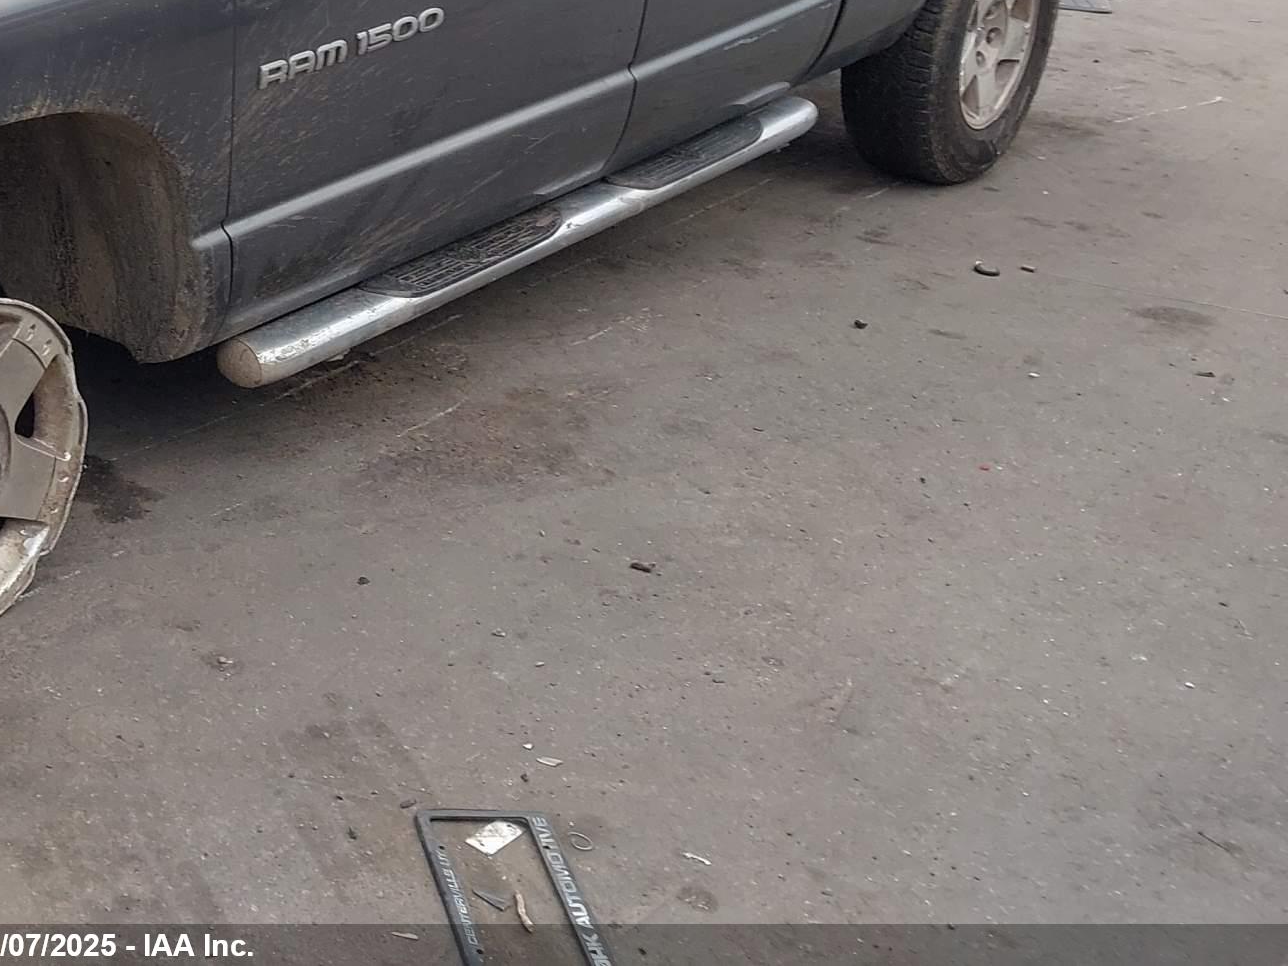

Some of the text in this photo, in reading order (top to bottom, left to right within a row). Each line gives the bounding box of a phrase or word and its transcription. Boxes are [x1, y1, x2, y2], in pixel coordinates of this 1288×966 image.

[259, 7, 444, 90] RAM 1500
[532, 816, 594, 929] AUTOMOTIVE
